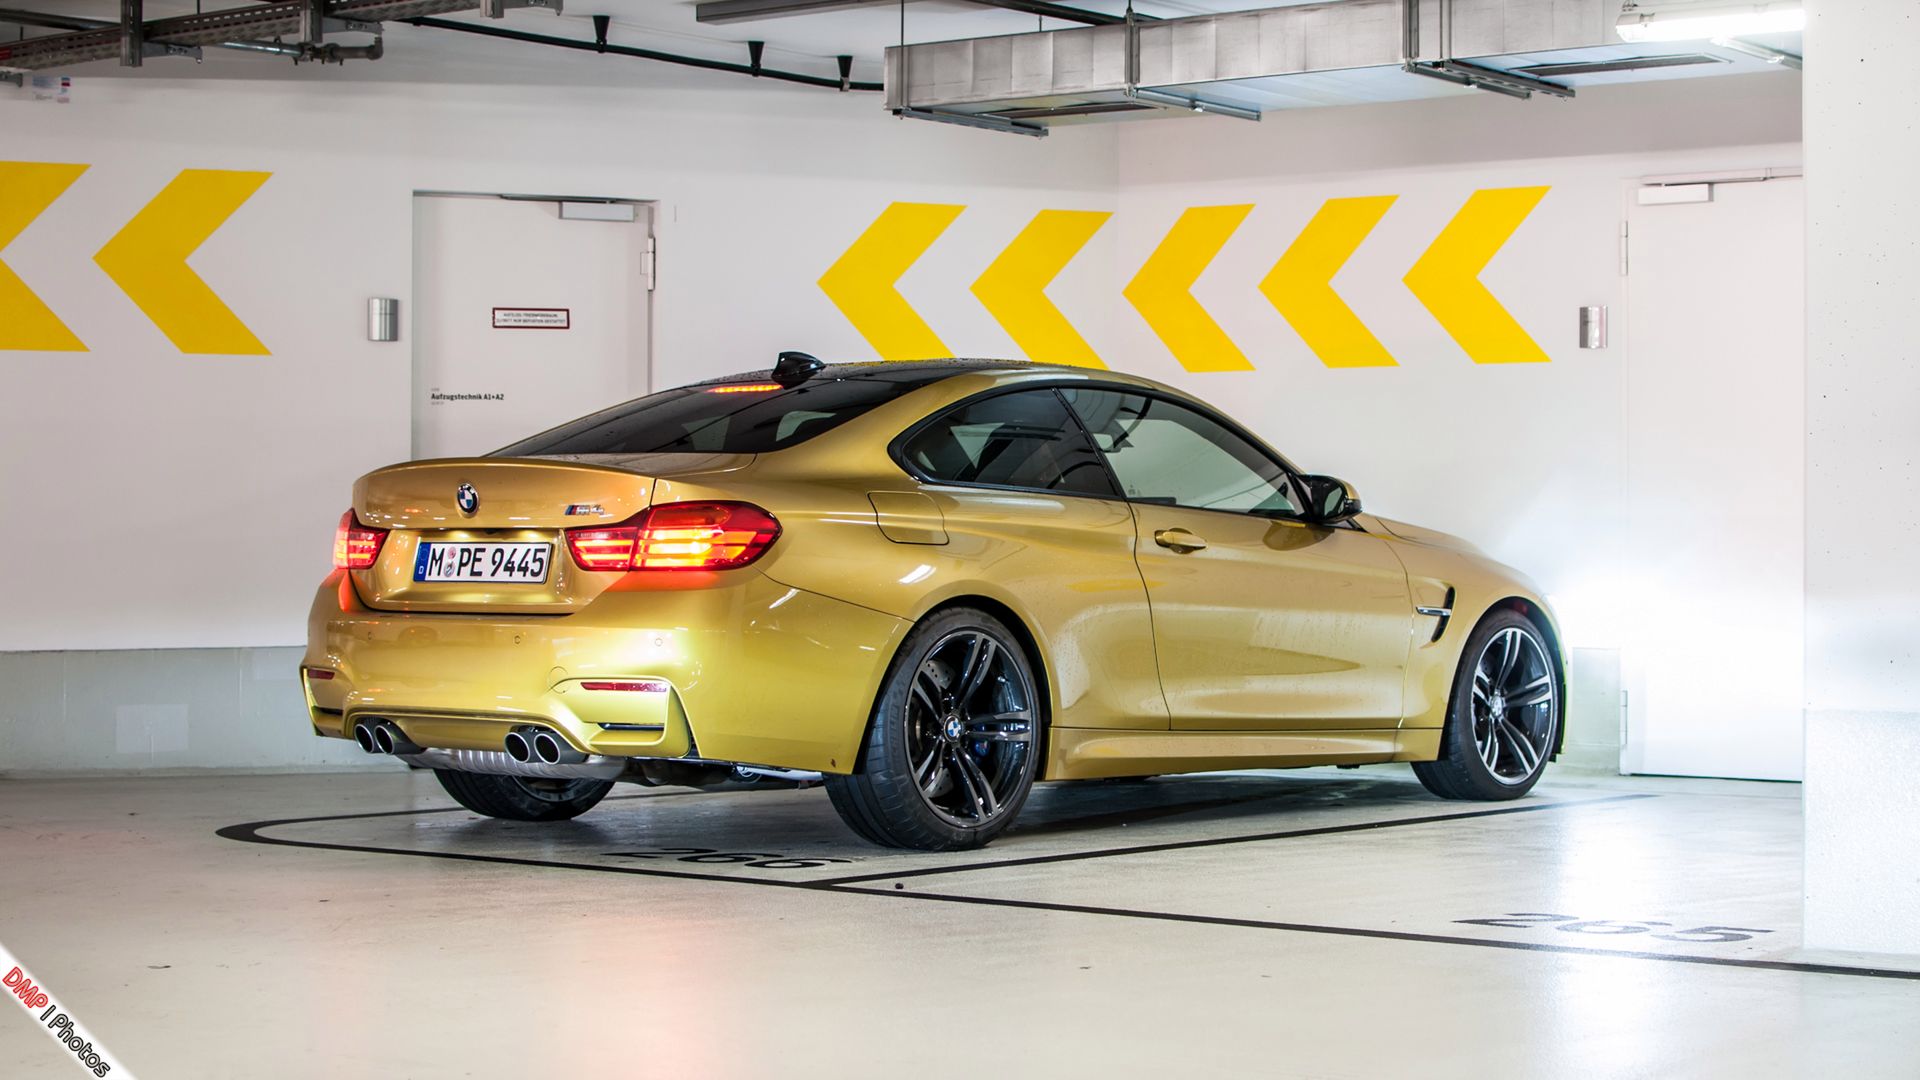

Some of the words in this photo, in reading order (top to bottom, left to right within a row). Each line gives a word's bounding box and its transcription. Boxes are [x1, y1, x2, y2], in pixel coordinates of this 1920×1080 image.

[431, 393, 482, 401] Aufzugstechnik
[428, 548, 445, 577] M
[456, 547, 486, 577] PE
[490, 548, 547, 578] 9445
[600, 847, 853, 869] 266
[1450, 912, 1776, 942] 265
